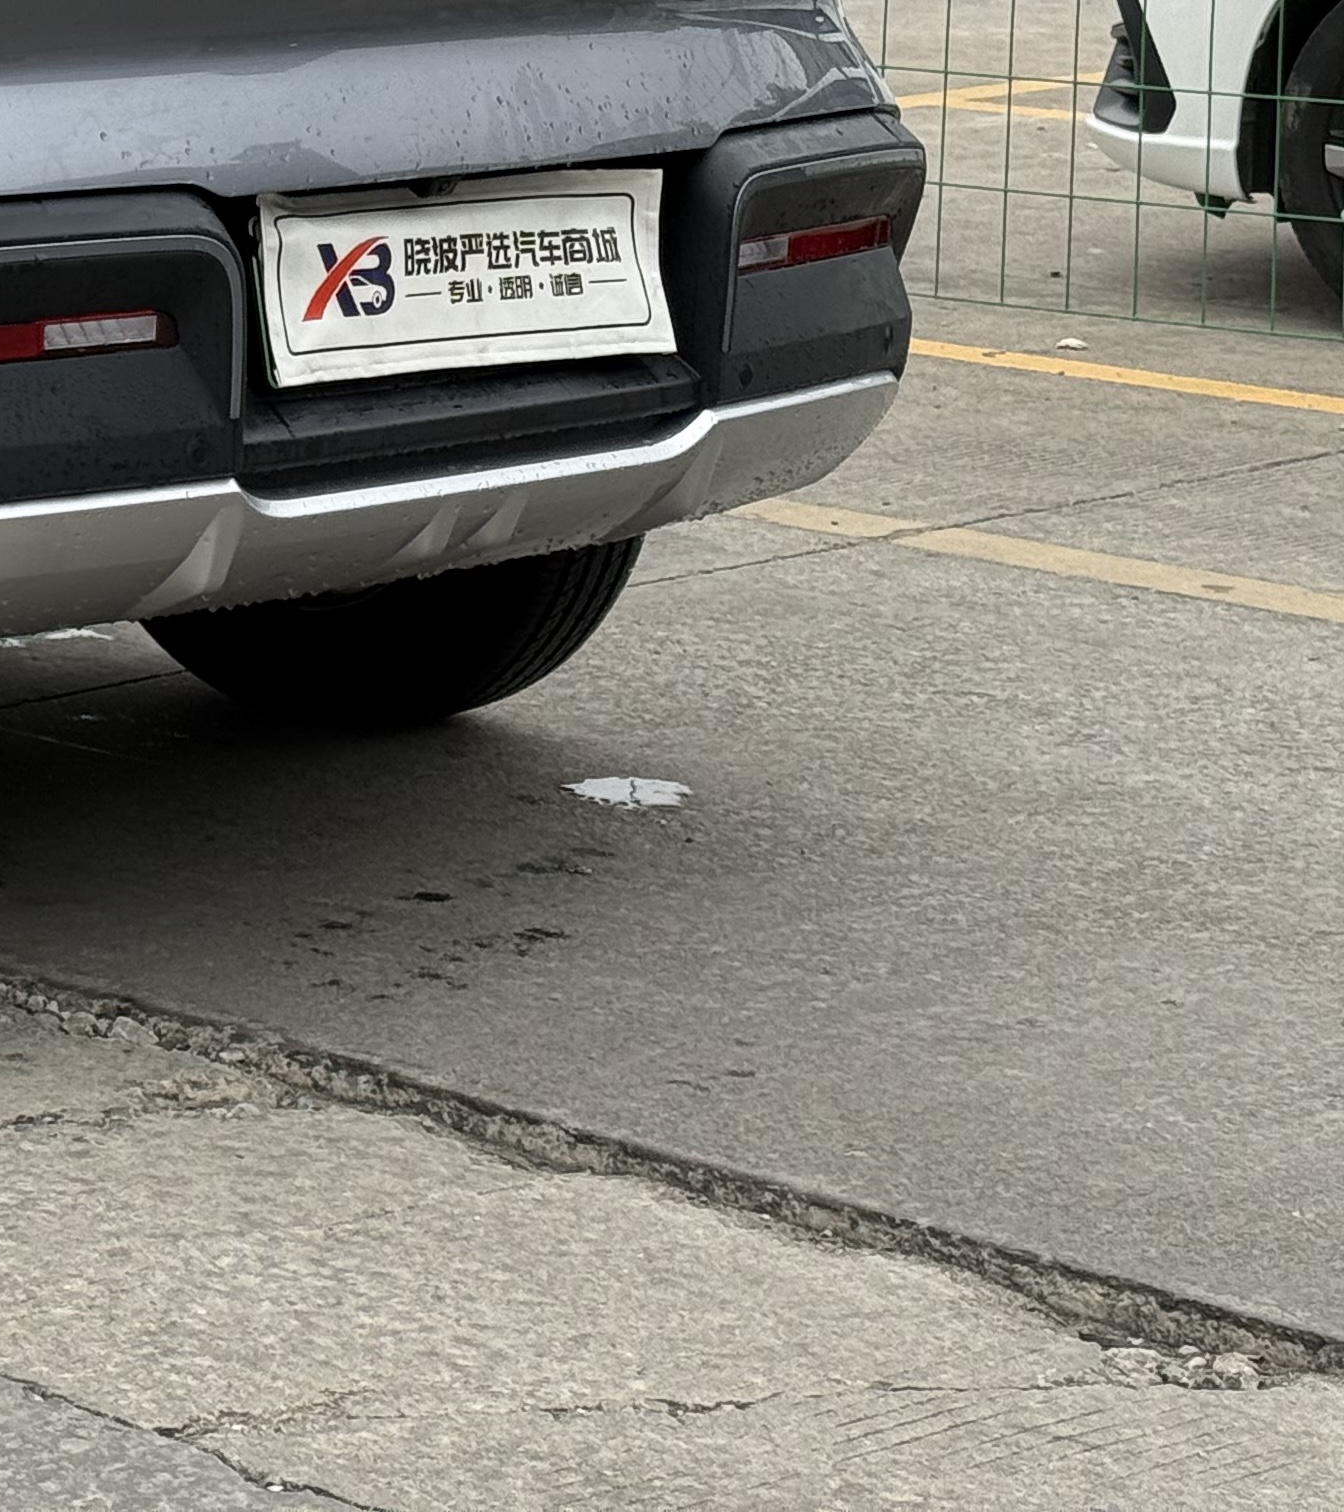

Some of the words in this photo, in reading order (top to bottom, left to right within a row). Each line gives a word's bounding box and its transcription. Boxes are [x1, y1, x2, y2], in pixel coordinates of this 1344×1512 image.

[403, 226, 622, 277] 晓波严选汽车商城
